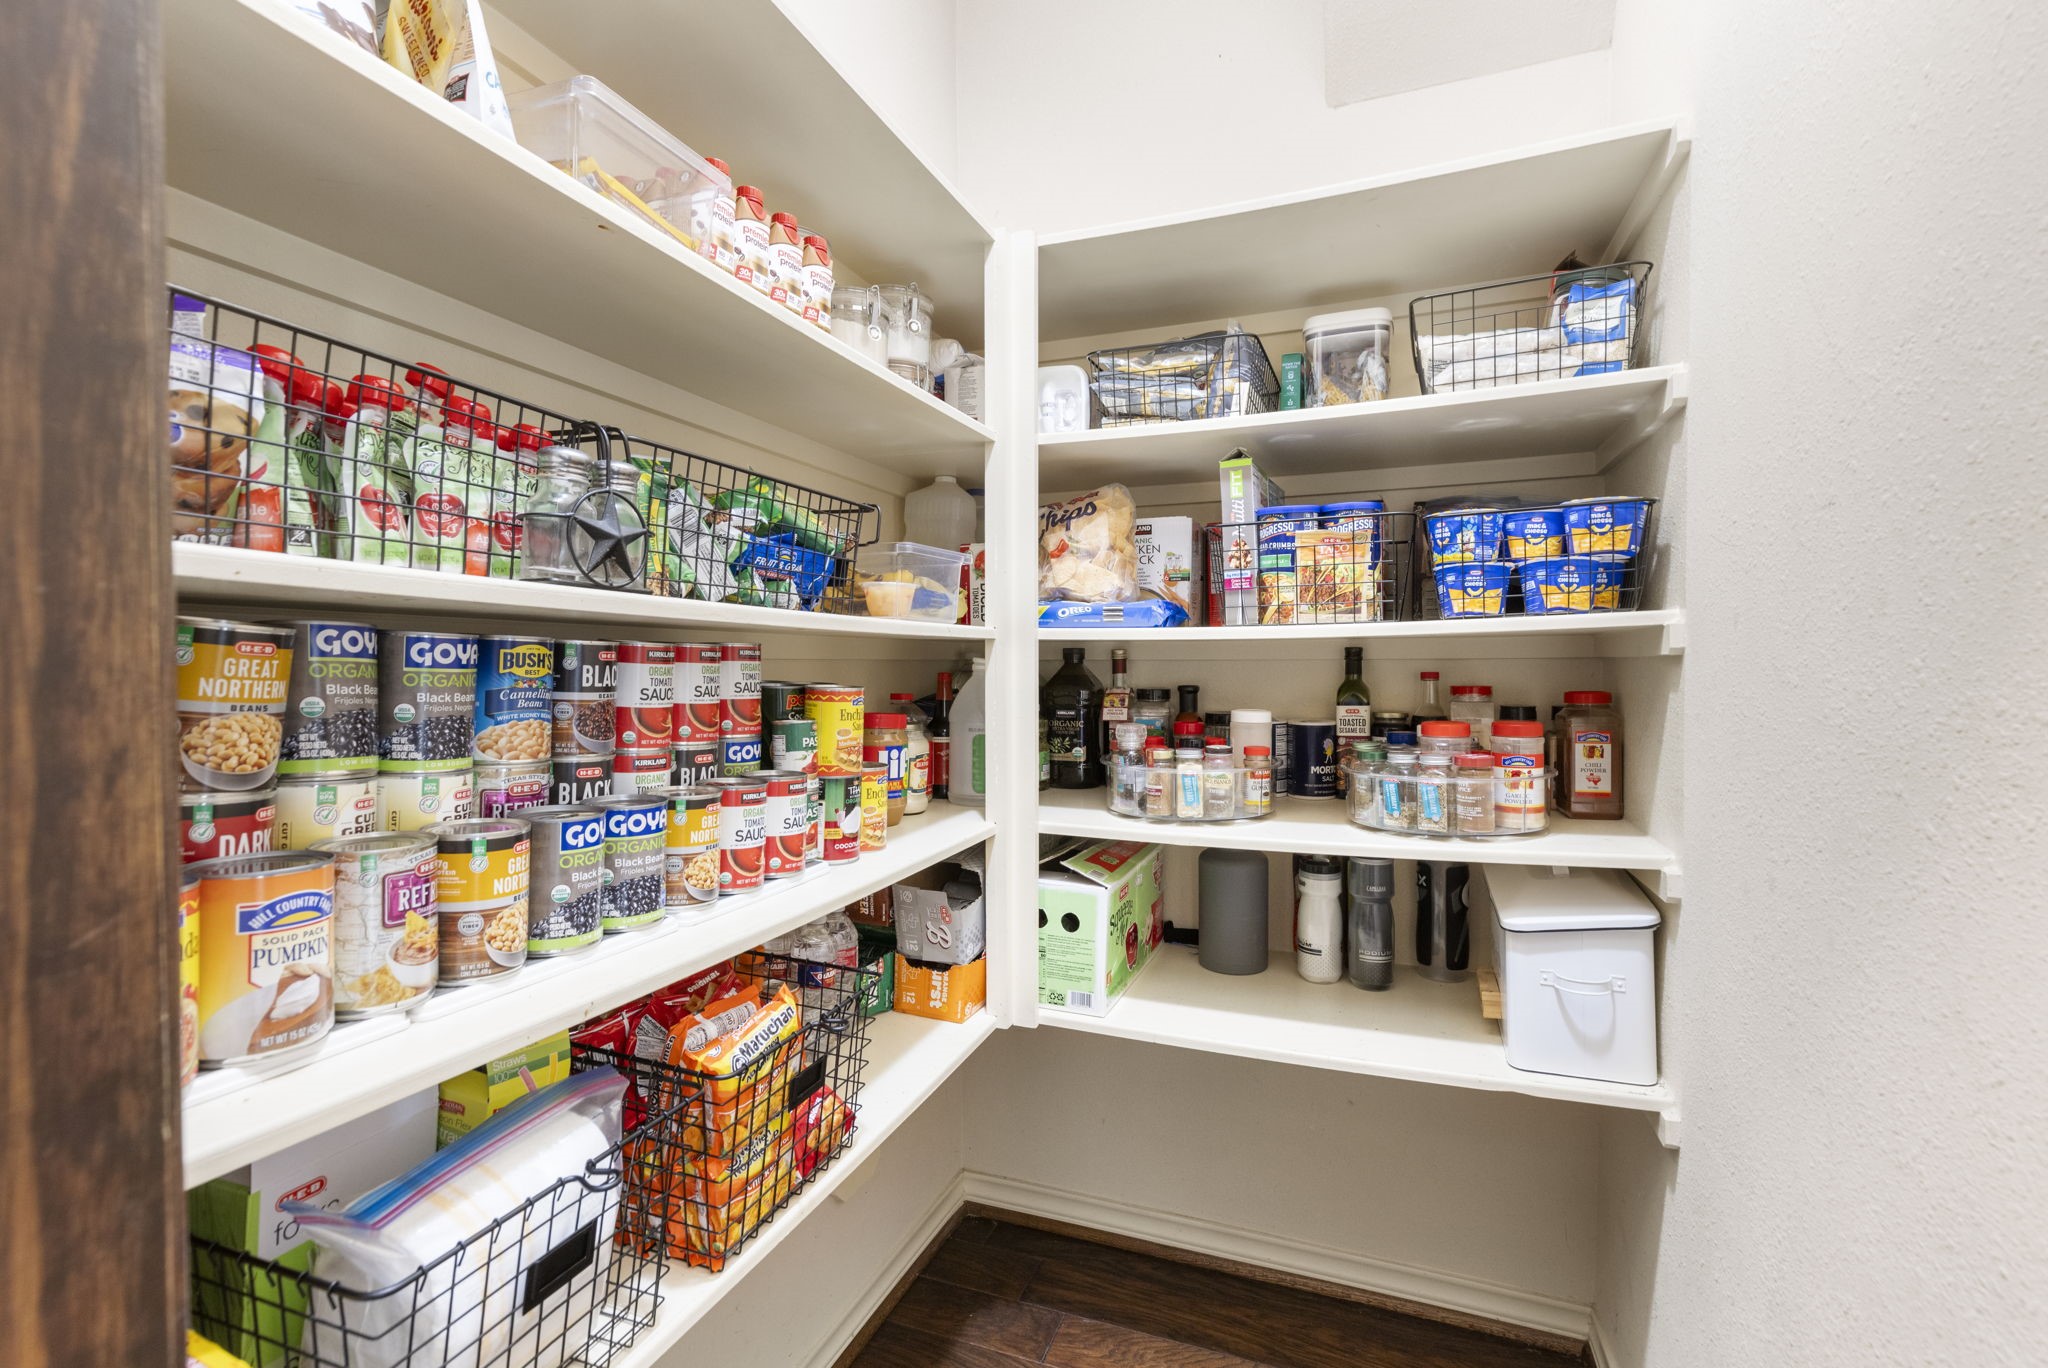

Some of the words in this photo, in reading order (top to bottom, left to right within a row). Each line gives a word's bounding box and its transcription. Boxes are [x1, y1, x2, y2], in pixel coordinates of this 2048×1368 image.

[399, 16, 431, 78] SWEETENED
[743, 226, 769, 243] premie
[777, 250, 802, 266] premie
[1231, 472, 1242, 498] FIT
[972, 587, 980, 619] TOMATOES
[1057, 606, 1092, 619] OREO
[316, 628, 378, 655] GOY
[410, 641, 479, 666] GOYA
[223, 657, 279, 678] GREAT
[503, 651, 552, 671] BUSH'S
[309, 663, 377, 678] ORGAN
[582, 665, 617, 687] BLAC
[198, 677, 286, 699] NORTHERN
[326, 684, 362, 695] Black
[364, 685, 378, 695] Bea
[694, 685, 720, 698] SAUC
[734, 682, 761, 693] SAUC
[335, 697, 363, 706] Frijoles
[417, 692, 451, 703] Black
[454, 693, 475, 702] Bean
[517, 700, 543, 708] Beans
[230, 704, 269, 712] BEANS
[424, 704, 452, 712] Frijoles
[1049, 720, 1084, 728] ORGANIC
[1339, 719, 1367, 727] TOASTED
[802, 737, 818, 747] PAS
[728, 744, 760, 762] GOY
[635, 758, 666, 766] KIRKLAND
[635, 773, 665, 785] ORGANIC
[513, 784, 539, 793] H-E-B
[559, 779, 611, 805] BLACK
[454, 803, 472, 814] CUT
[355, 811, 375, 825] CUT
[609, 809, 667, 835] GOYA
[783, 817, 806, 829] SAU
[735, 827, 766, 842] SAUC
[219, 828, 271, 857] DARK
[615, 857, 644, 868] Black
[571, 869, 597, 882] Black
[248, 909, 276, 929] HILL
[276, 895, 318, 915] COUNTRY
[860, 896, 869, 915] EER
[262, 934, 298, 946] SOLID
[911, 939, 918, 951] 12
[252, 935, 328, 969] PUMPKIN
[687, 971, 720, 993] ORIGINAL
[930, 970, 942, 1008] urst
[909, 992, 915, 1004] 12
[261, 1036, 276, 1047] NET
[276, 1034, 288, 1045] WT
[492, 1054, 527, 1072] Straws
[494, 1071, 509, 1084] 100
